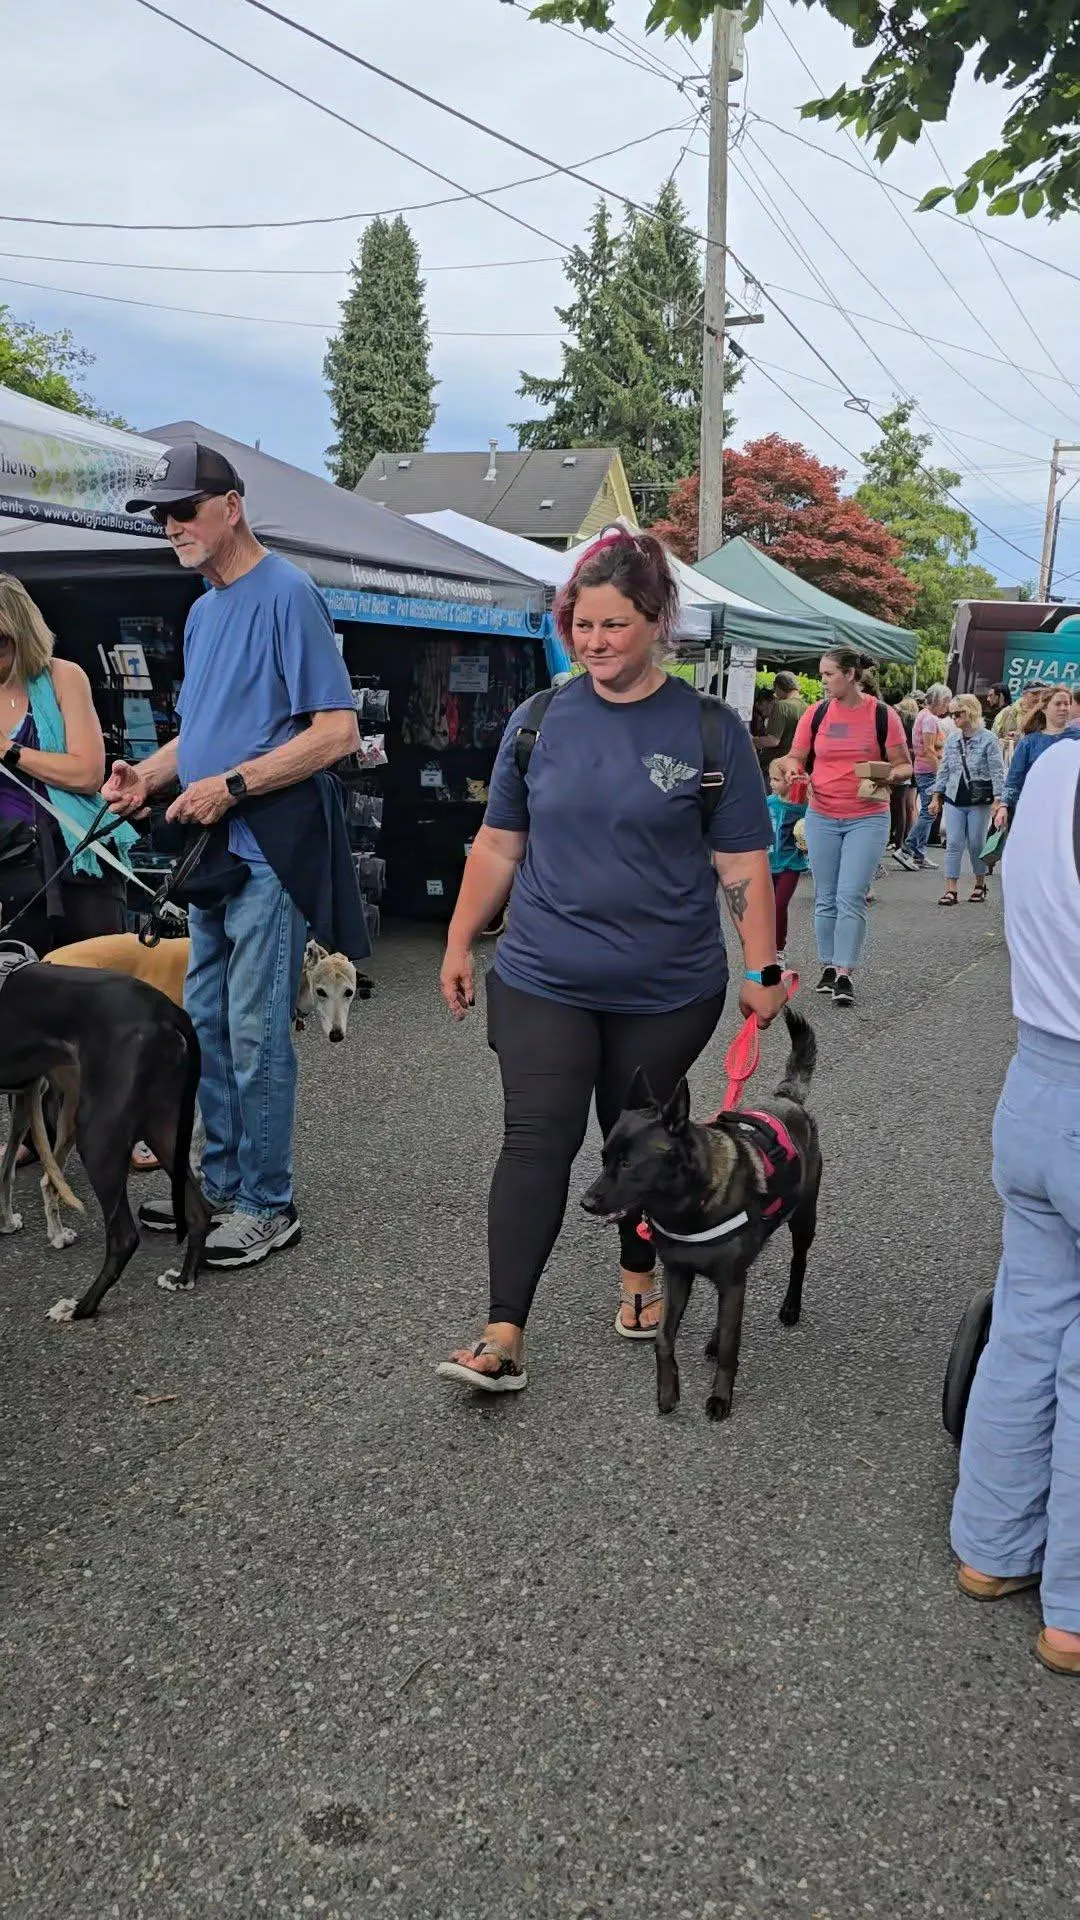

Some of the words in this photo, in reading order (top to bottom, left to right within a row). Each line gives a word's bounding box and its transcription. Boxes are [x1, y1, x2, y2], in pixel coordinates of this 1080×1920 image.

[0, 453, 37, 478] hews
[352, 564, 405, 594] Howling
[406, 574, 434, 593] Mad
[437, 578, 492, 600] Creations
[1008, 658, 1080, 679] SHAR
